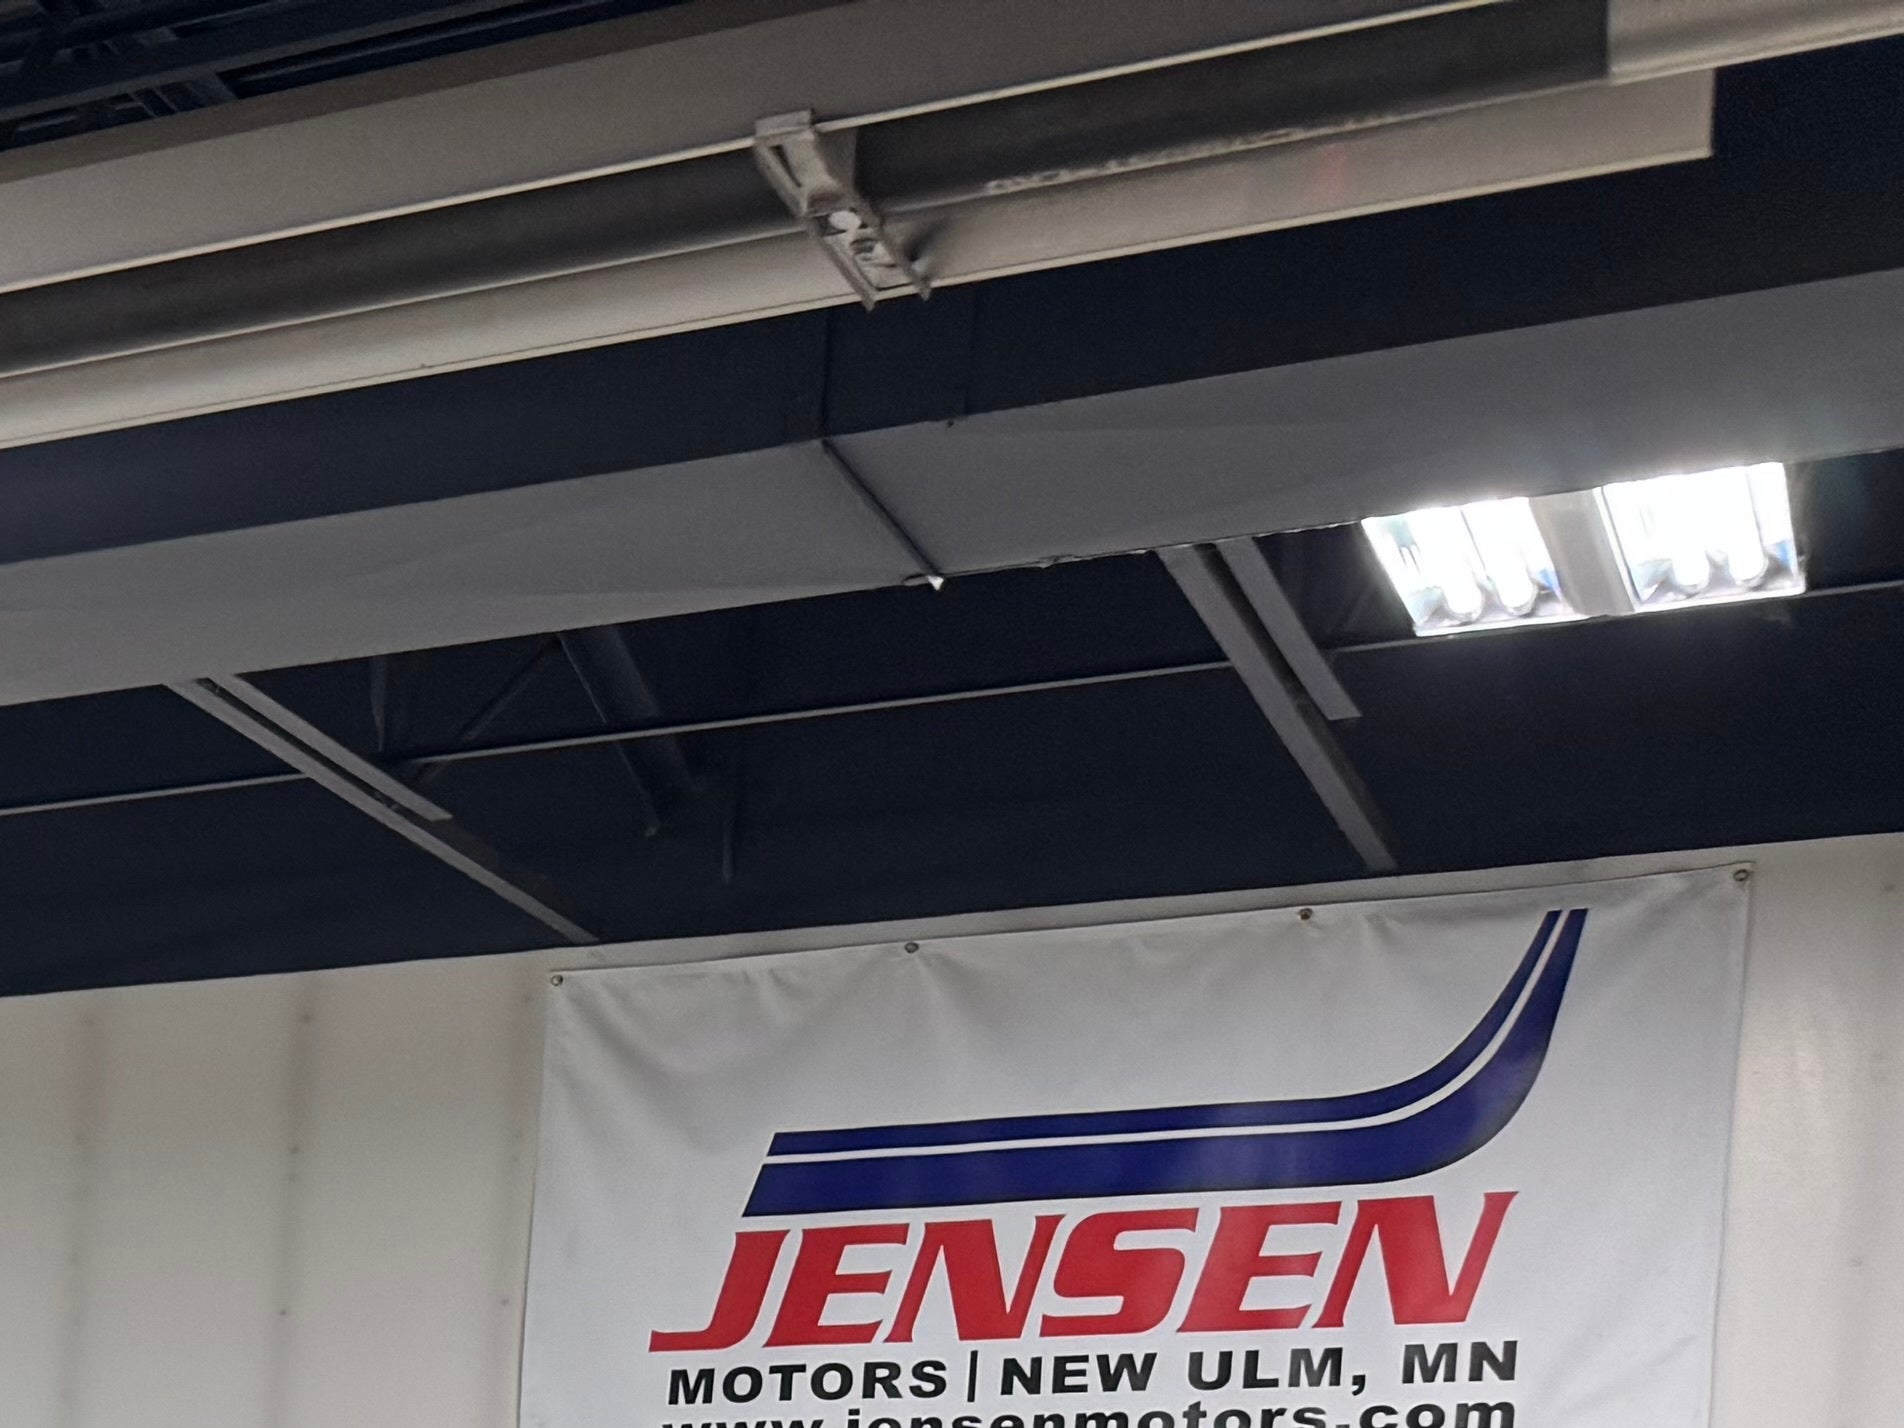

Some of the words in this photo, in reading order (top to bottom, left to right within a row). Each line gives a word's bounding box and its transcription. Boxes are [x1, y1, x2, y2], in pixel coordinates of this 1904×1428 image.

[648, 1191, 1520, 1353] JENSEN
[667, 1359, 948, 1406] MOTORS
[1000, 1352, 1158, 1396] NEW
[1187, 1346, 1367, 1396] ULM,
[1402, 1340, 1518, 1385] MN
